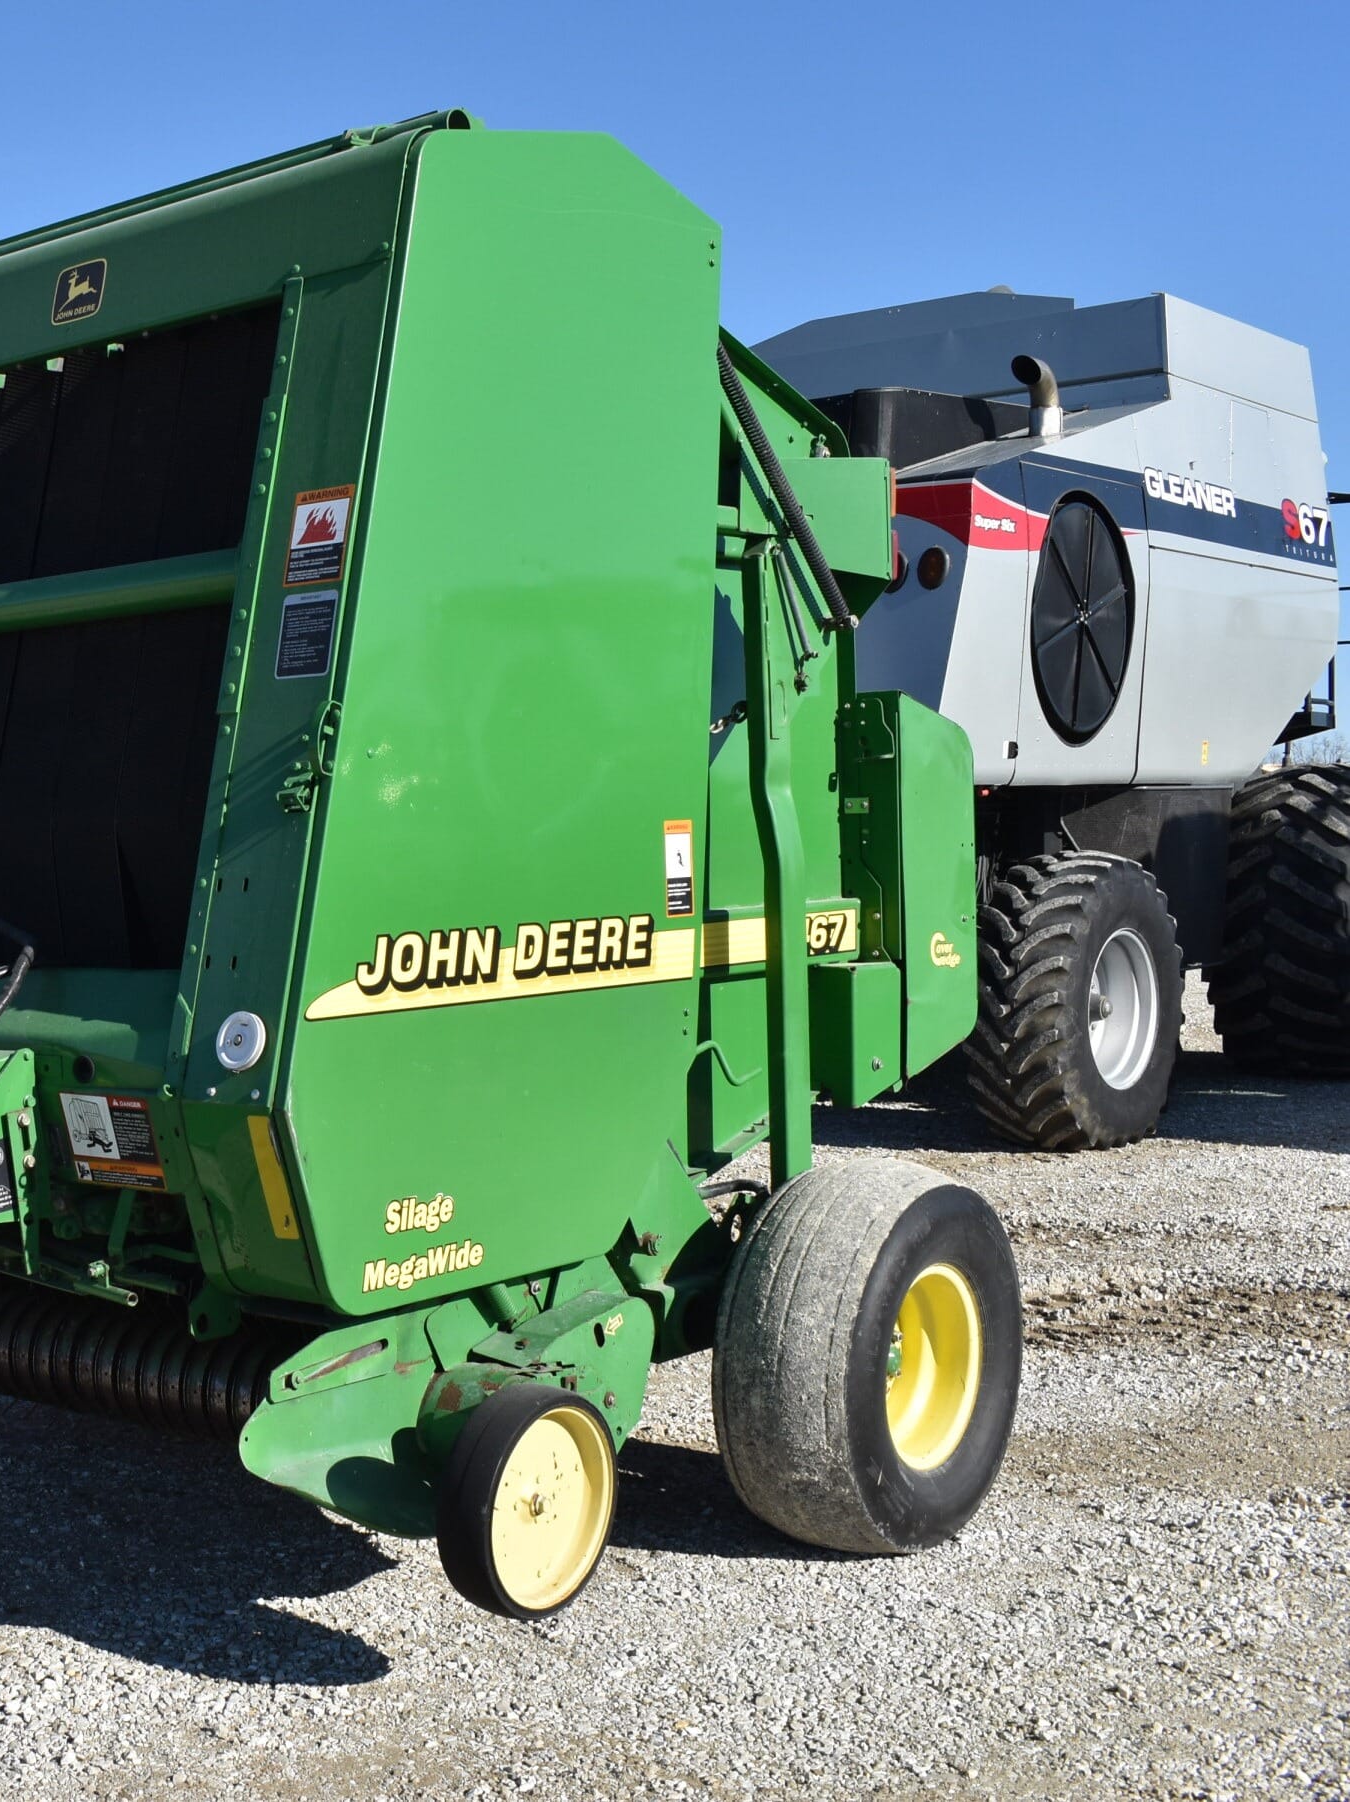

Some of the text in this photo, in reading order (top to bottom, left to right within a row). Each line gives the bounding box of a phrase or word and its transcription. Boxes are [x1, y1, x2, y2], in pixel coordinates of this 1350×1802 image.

[55, 303, 96, 321] JOHN DEERE
[309, 487, 350, 501] WARNING
[1144, 466, 1237, 518] GLEANER
[974, 513, 1016, 533] Super Six
[1281, 498, 1328, 547] S67
[356, 914, 655, 994] JOHN DEERE
[119, 1101, 142, 1109] DANGER
[384, 1196, 455, 1234] Silage
[362, 1239, 484, 1293] MegaWide
